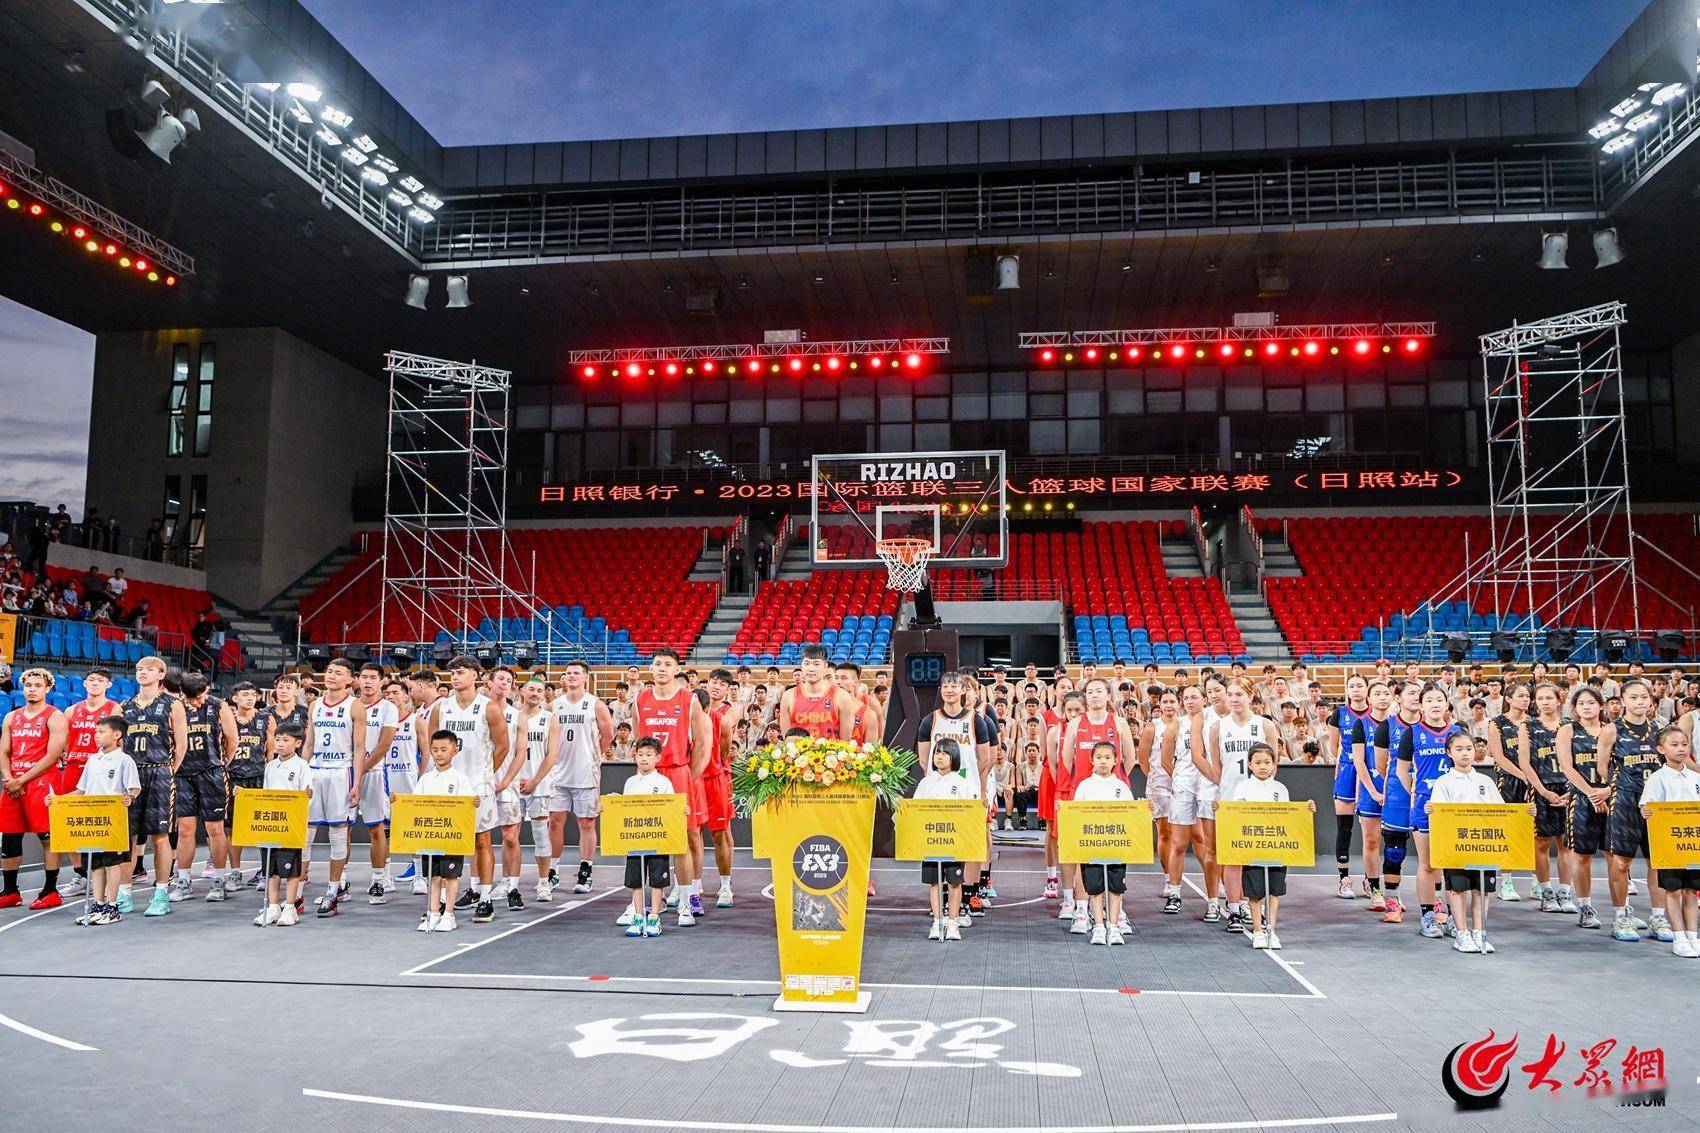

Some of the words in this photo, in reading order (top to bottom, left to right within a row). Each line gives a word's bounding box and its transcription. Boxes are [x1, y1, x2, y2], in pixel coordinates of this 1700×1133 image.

[860, 461, 956, 482] RIZHAO
[558, 714, 567, 724] NEW
[567, 714, 585, 724] ZEALAND
[645, 718, 678, 726] SINGAPORE
[795, 711, 833, 724] CHINA
[72, 720, 98, 729] JAPA
[313, 720, 346, 729] MONGOLIA
[12, 729, 42, 738] JAPAN
[566, 729, 574, 742] 0
[652, 731, 670, 747] 57
[77, 733, 92, 747] 13
[134, 737, 147, 752] 10
[188, 736, 204, 751] 12
[323, 733, 332, 747] 3
[235, 746, 251, 760] 23
[391, 746, 400, 759] 6
[1224, 741, 1236, 753] NEW
[1419, 748, 1446, 757] MONG
[1438, 758, 1450, 773] 4
[66, 816, 113, 827] 马来西亚队
[253, 810, 288, 822] 蒙古国队
[413, 816, 453, 828] 新西兰队
[623, 816, 664, 828] 新加坡队
[70, 830, 110, 838] MALAYSIA
[250, 824, 289, 833] MONGOLIA
[924, 822, 957, 834] 中国队
[1082, 824, 1127, 835] 新加坡队
[1241, 825, 1288, 837] 新西兰队
[1456, 827, 1506, 840] 蒙古国队
[403, 830, 423, 838] NEW
[424, 831, 463, 840] ZEALAND
[619, 831, 668, 840] SINGAPORE
[926, 837, 955, 845] CHINA
[809, 844, 831, 852] FIBA
[1079, 839, 1132, 847] SINGAPORE
[1231, 840, 1254, 849] NEW
[1255, 840, 1300, 850] ZEALAND
[1455, 843, 1510, 853] MONGOLIA
